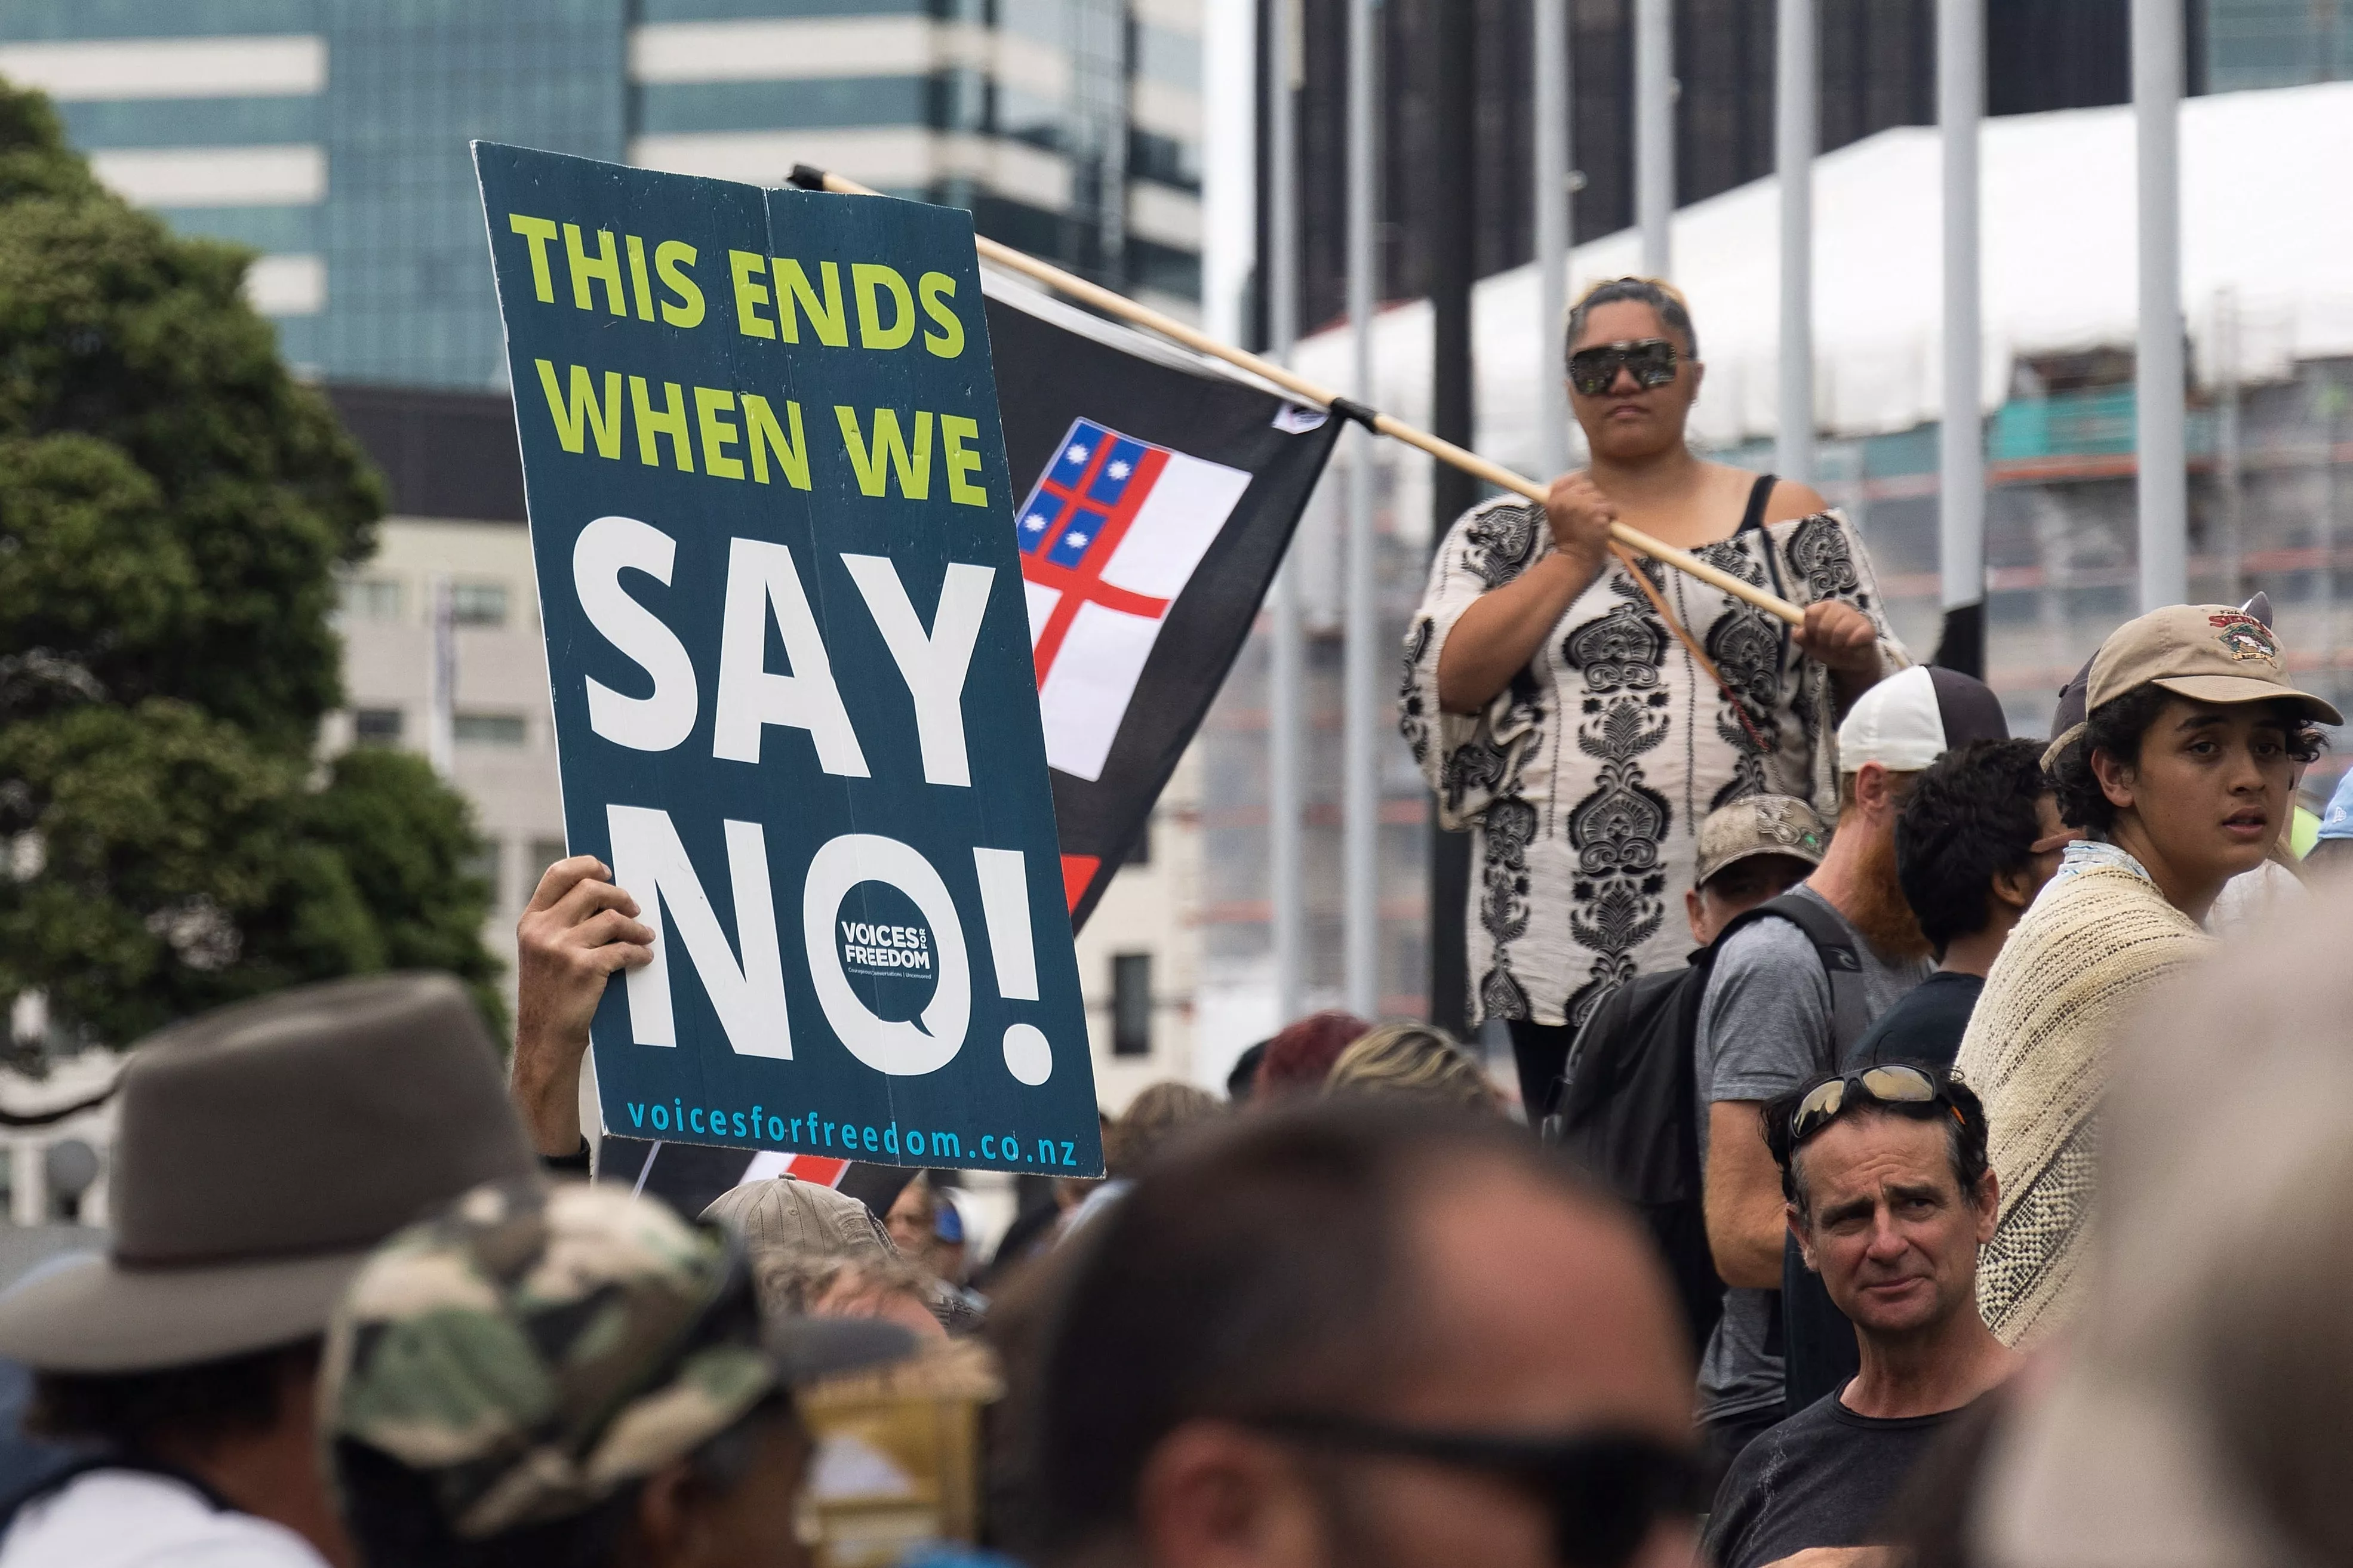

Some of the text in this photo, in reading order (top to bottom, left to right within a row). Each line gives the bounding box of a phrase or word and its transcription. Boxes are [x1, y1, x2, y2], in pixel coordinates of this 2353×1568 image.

[509, 213, 965, 359] THIS ENDS
[535, 359, 988, 508] WHEN WE
[573, 516, 996, 788] SAY
[606, 804, 1053, 1086] NO!
[841, 921, 919, 949] VOICES
[845, 944, 930, 969] FREEDOM
[919, 928, 928, 949] FOR
[627, 1098, 1077, 1166] voicesforfreedom.co.nz
